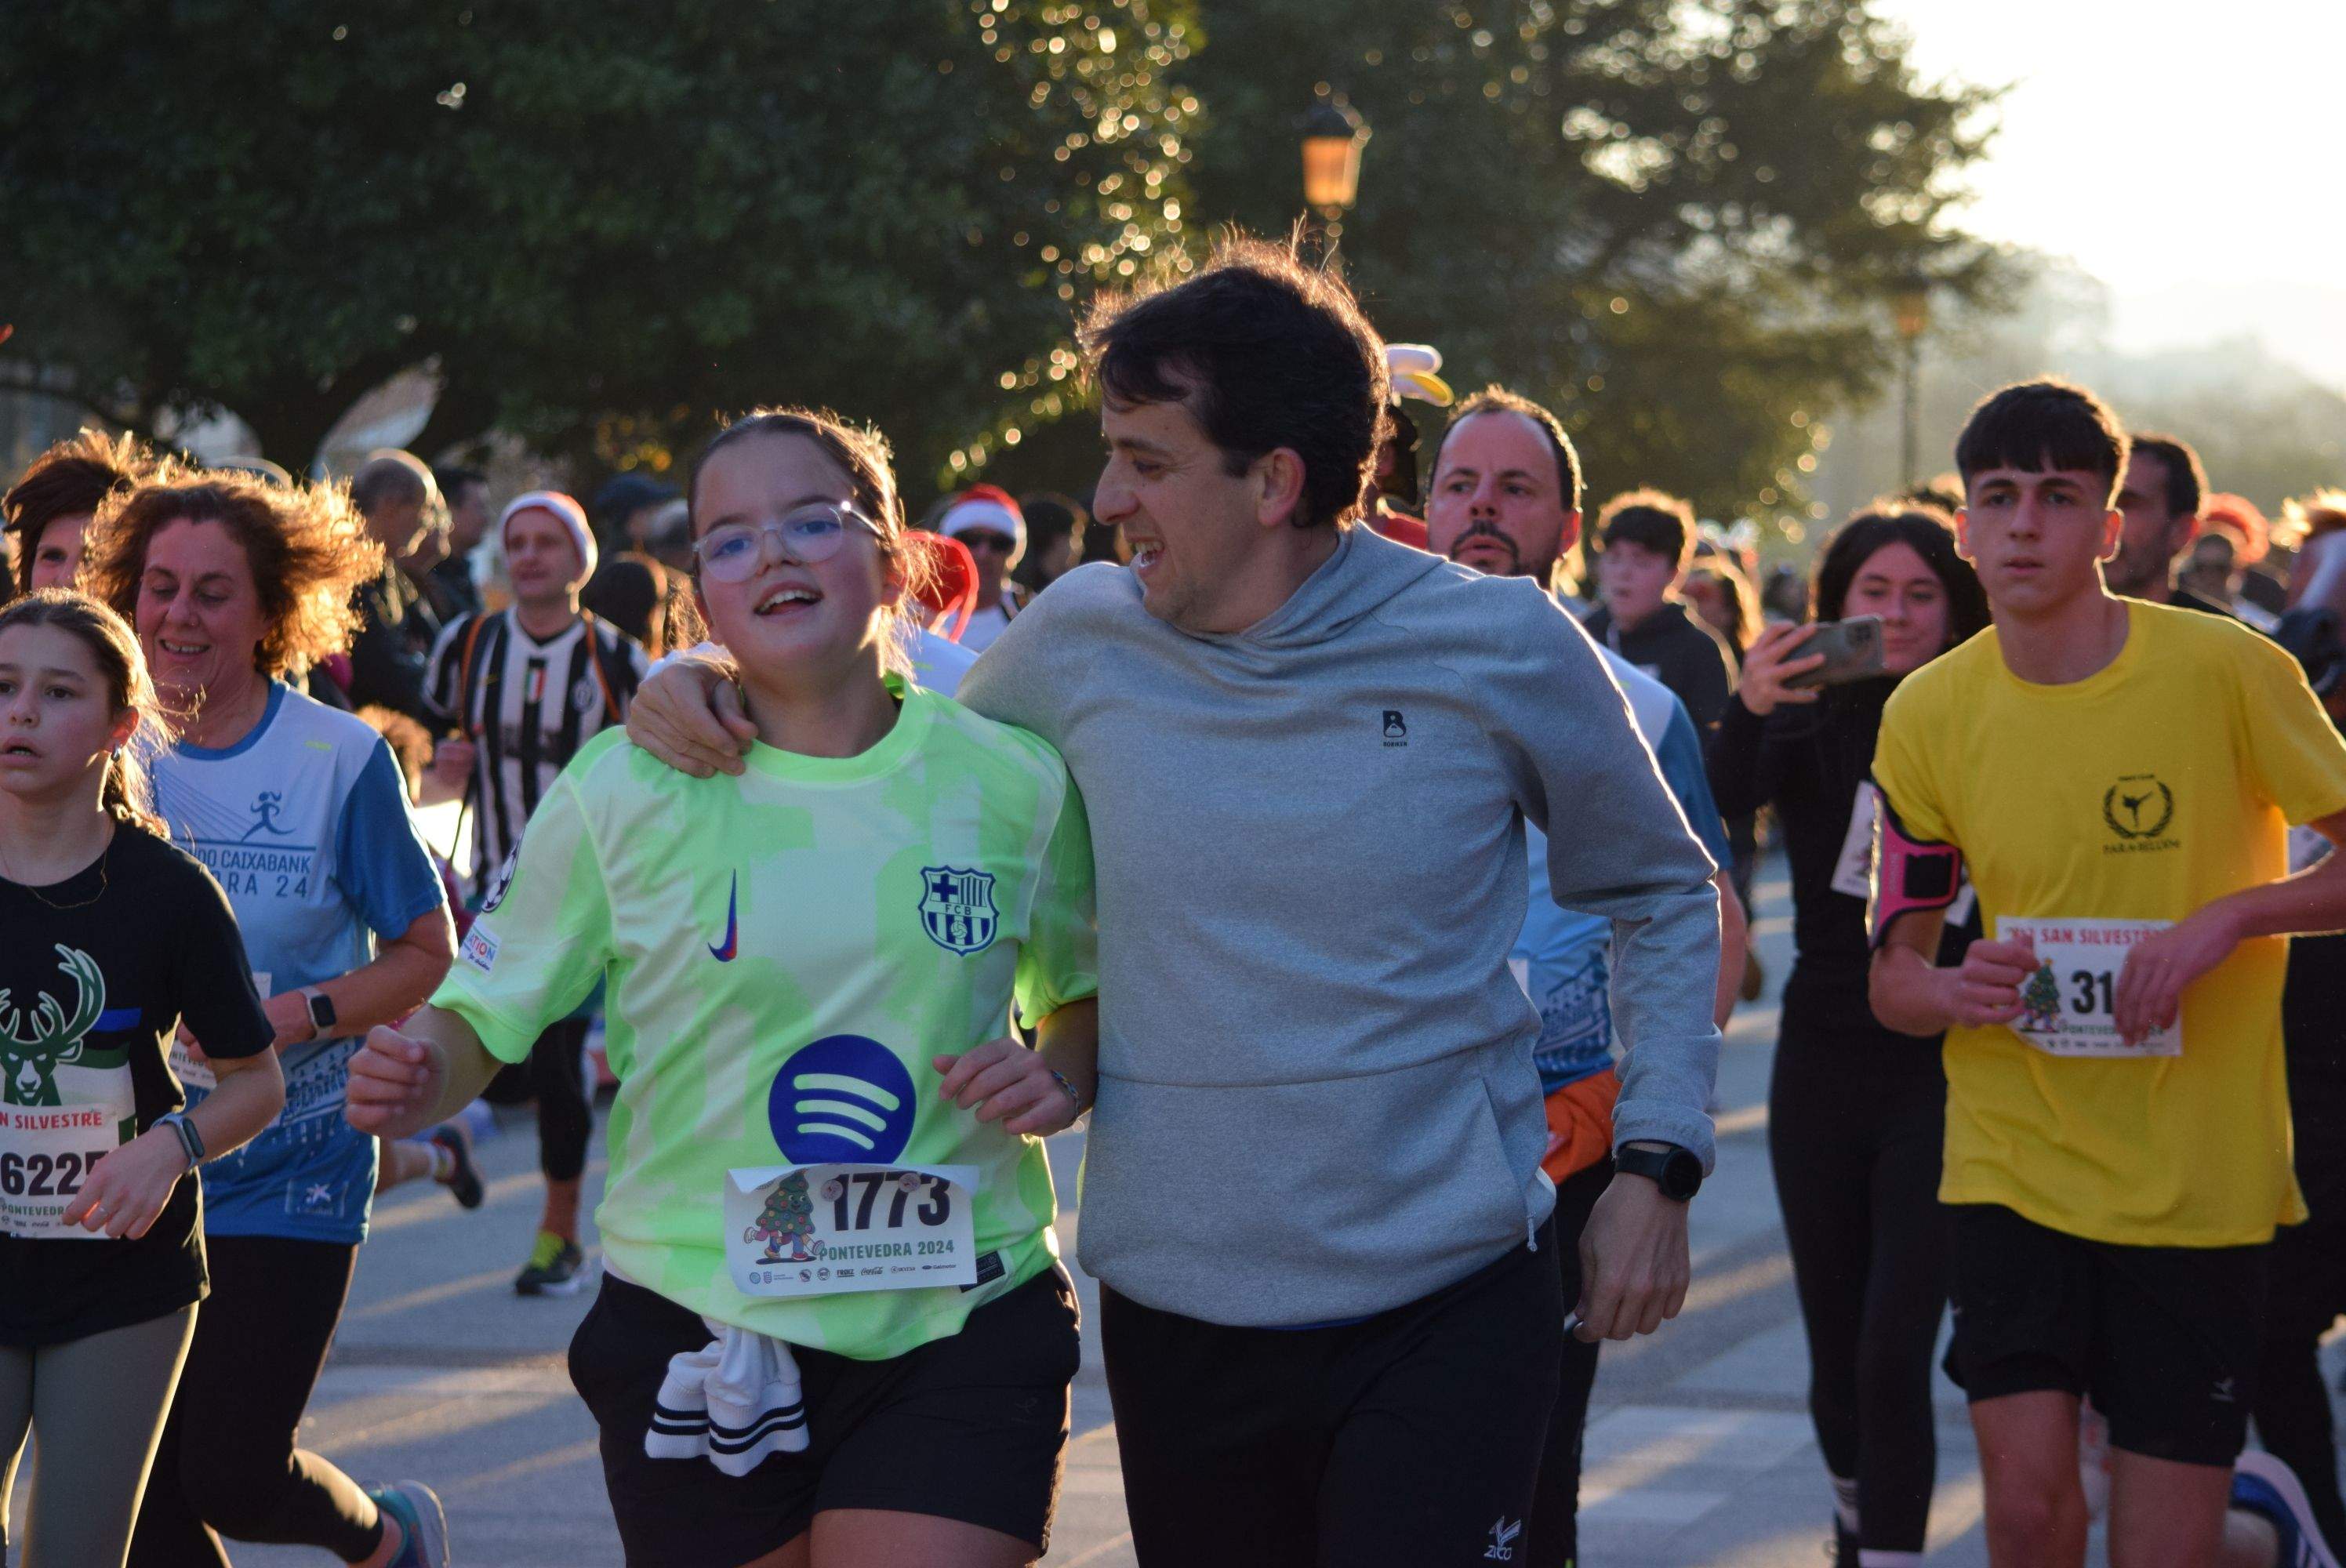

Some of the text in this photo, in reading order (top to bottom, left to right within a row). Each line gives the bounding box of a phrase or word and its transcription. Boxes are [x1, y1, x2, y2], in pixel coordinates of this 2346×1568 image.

[222, 849, 311, 874] CAIXABANK
[275, 874, 307, 898] 24
[945, 904, 971, 916] FCB
[2040, 928, 2073, 943] SAN
[2071, 969, 2113, 1014] 31
[15, 1111, 103, 1130] SILVESTRE
[2, 1203, 64, 1216] PONTEVEDR
[833, 1171, 951, 1232] 1773
[819, 1239, 955, 1261] PONTEVEDRA 2024
